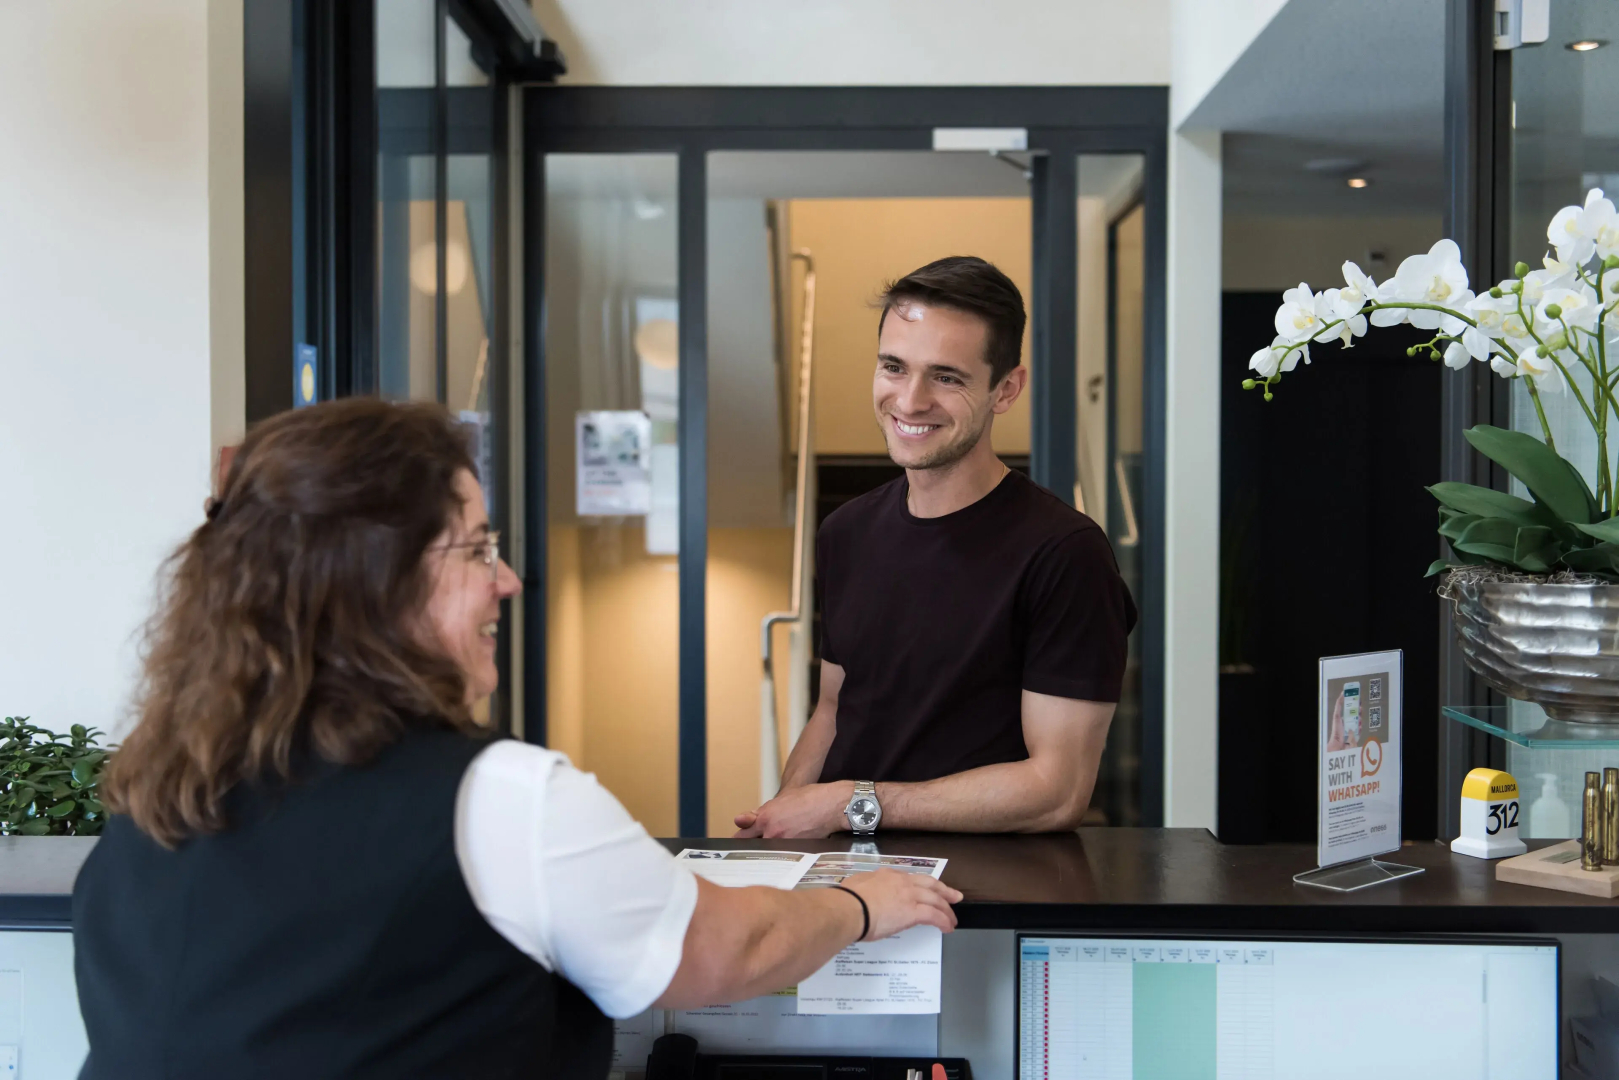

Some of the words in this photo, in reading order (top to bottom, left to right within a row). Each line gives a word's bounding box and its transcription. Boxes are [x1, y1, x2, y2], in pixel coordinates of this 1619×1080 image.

[1328, 756, 1346, 771] SAY
[1348, 754, 1356, 768] IT
[1328, 770, 1353, 786] WITH
[1328, 780, 1380, 802] WHATSAPP!
[1491, 783, 1517, 793] MALLORCA
[1485, 801, 1520, 835] 312
